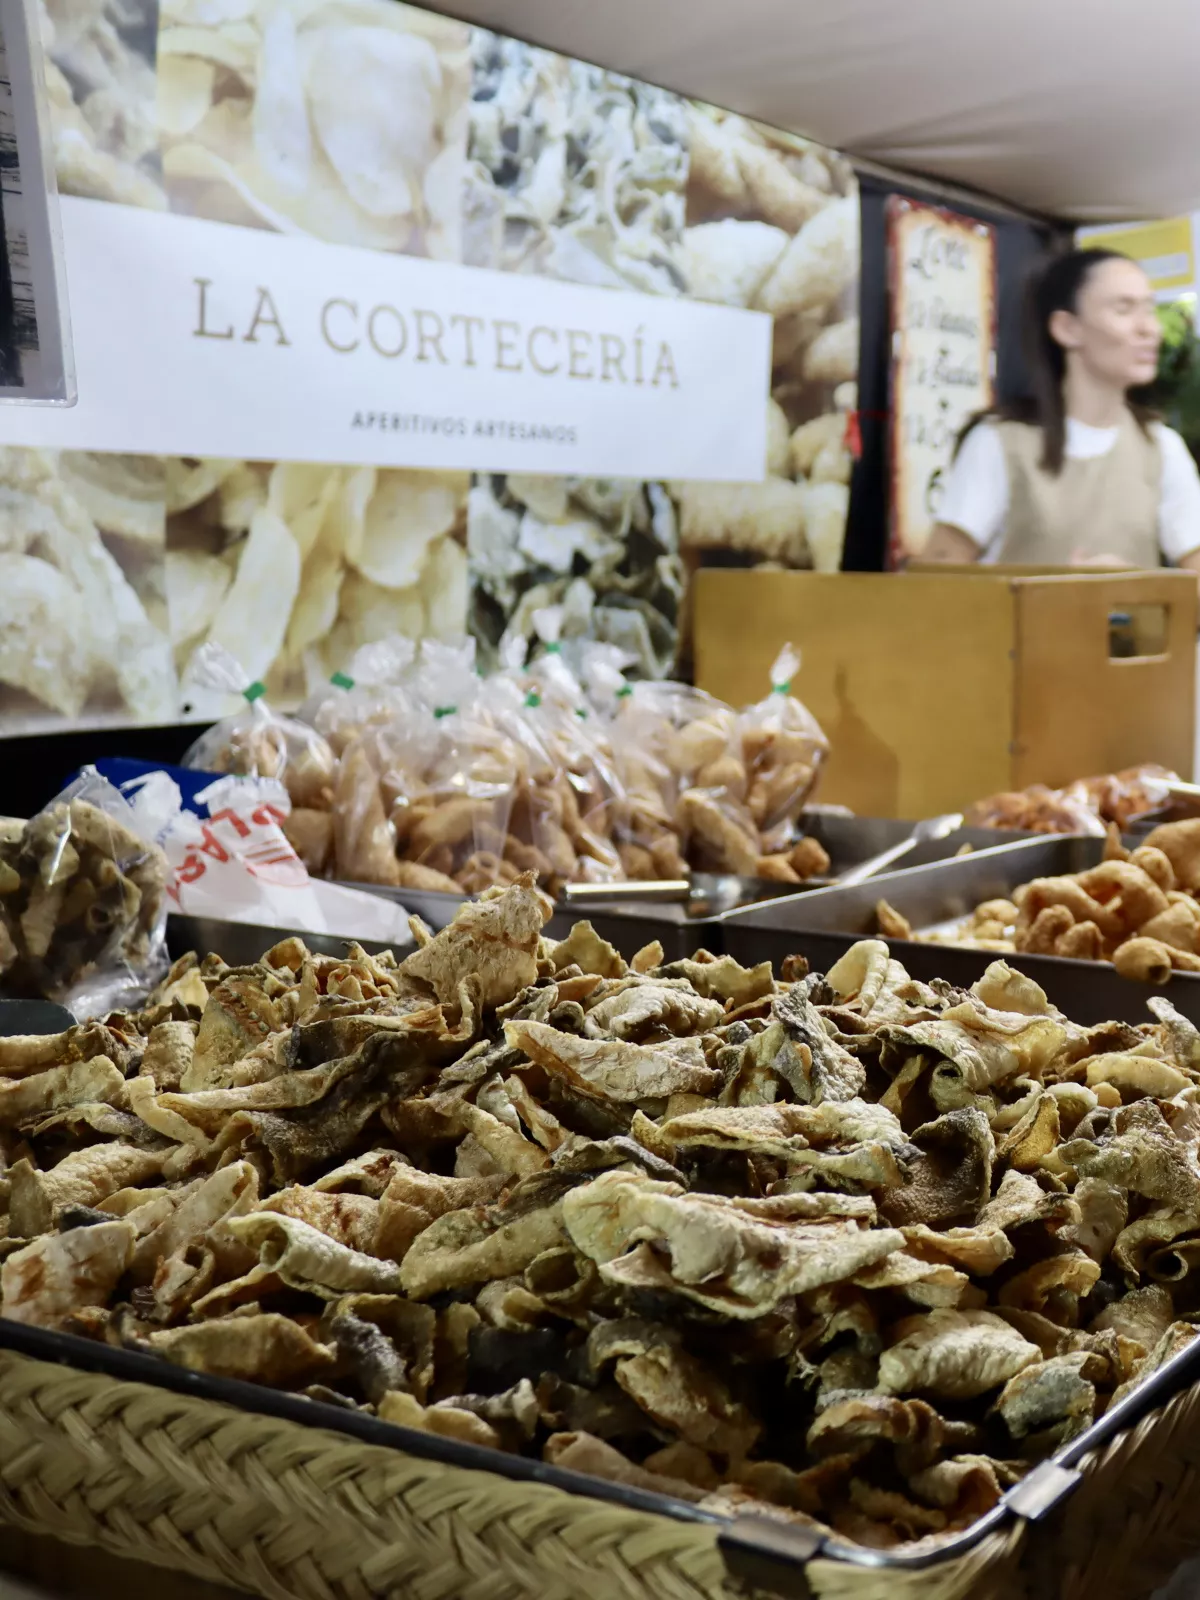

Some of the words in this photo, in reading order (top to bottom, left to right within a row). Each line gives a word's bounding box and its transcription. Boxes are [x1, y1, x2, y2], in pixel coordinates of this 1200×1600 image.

[192, 277, 292, 346] LA
[320, 297, 681, 389] CORTECERÍA
[351, 409, 467, 438] APERITIVOS
[472, 418, 578, 445] ARTESANOS
